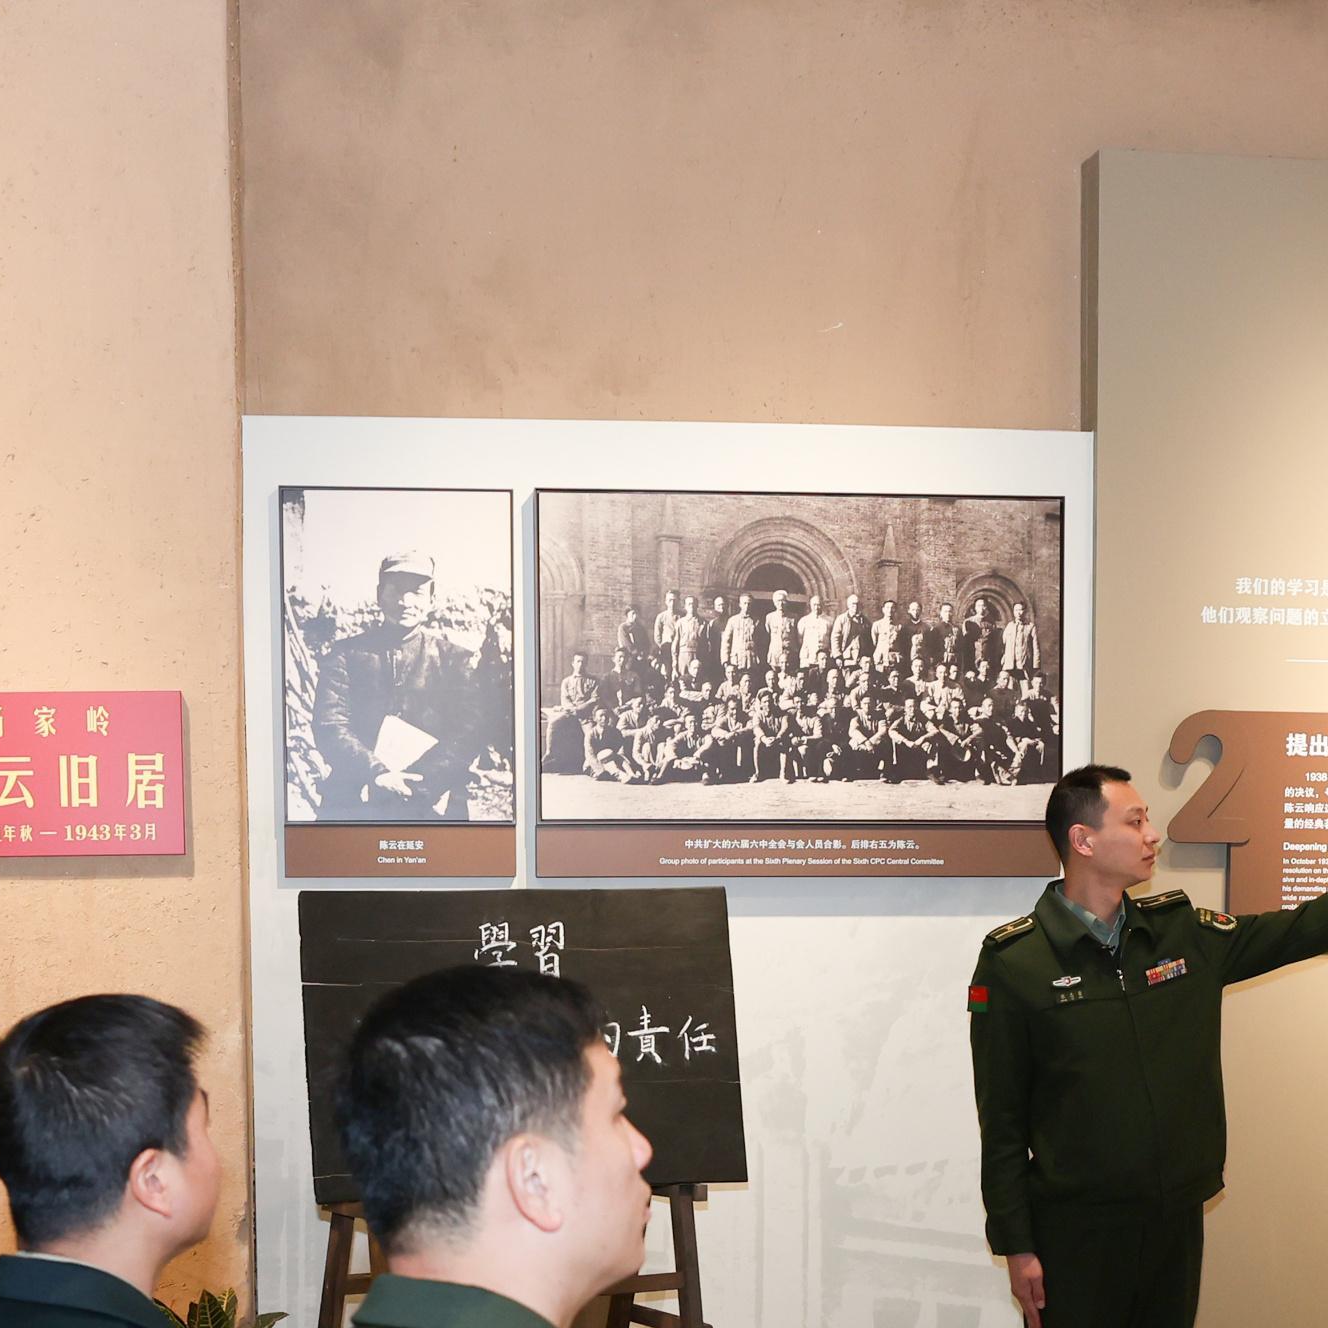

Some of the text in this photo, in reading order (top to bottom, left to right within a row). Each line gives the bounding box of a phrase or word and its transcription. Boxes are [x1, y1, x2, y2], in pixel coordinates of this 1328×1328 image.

[684, 839, 920, 850] 中共扩大的六届六中全会与会人员合影。后排右五为陈云。
[1283, 842, 1327, 852] Deepening
[659, 857, 680, 866] Group
[680, 857, 699, 866] photo
[708, 857, 744, 866] participants
[782, 857, 806, 866] Plenary
[807, 857, 832, 865] Session
[834, 857, 840, 865] of
[842, 857, 852, 865] the
[852, 857, 869, 865] Sixth
[870, 857, 885, 865] CPC
[886, 857, 909, 865] Central
[910, 857, 944, 865] Committee
[475, 921, 565, 978] 學習
